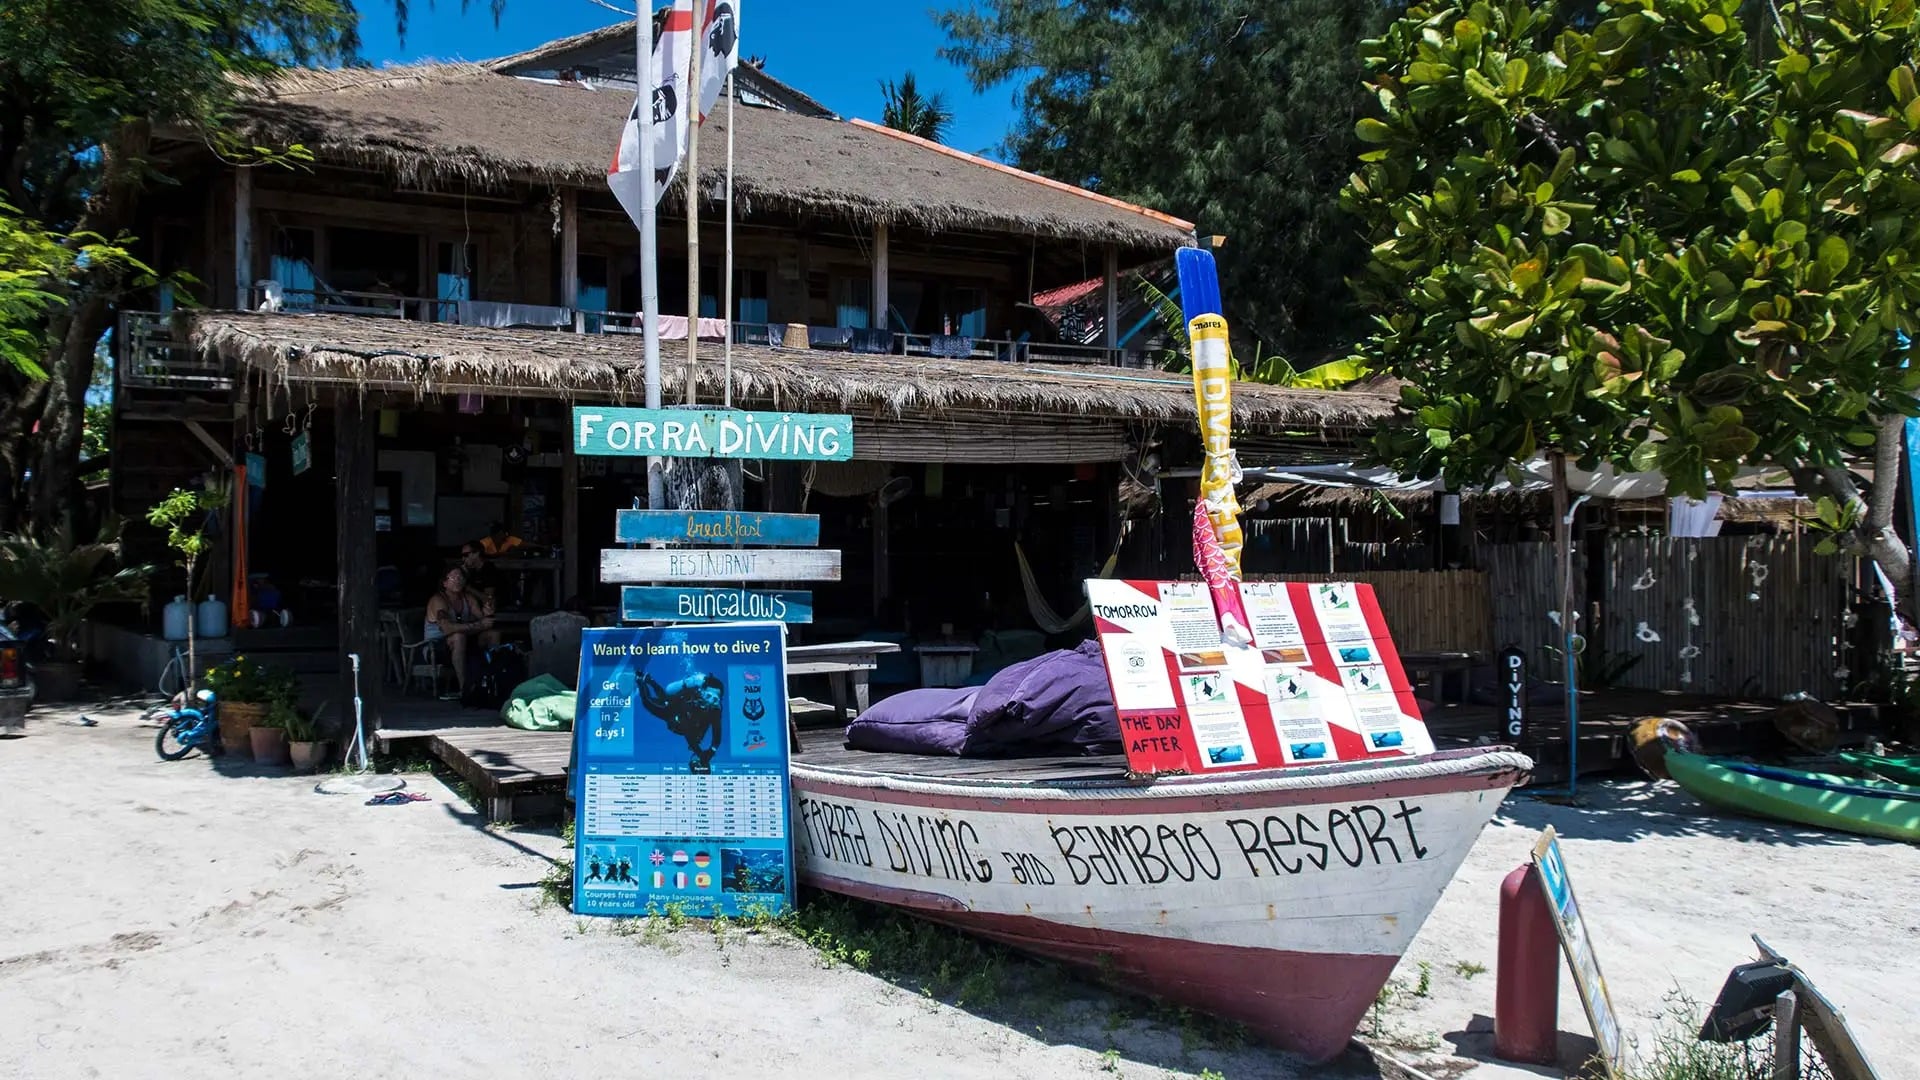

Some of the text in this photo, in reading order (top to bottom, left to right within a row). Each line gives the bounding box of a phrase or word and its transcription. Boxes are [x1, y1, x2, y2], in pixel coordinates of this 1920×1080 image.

[579, 414, 707, 452] FORRA
[686, 514, 763, 543] breakfast
[670, 553, 758, 576] RESTAURANT
[1094, 604, 1158, 618] TOMORROW
[593, 640, 771, 656] Want to learn how to dive ?
[602, 681, 620, 691] Get
[590, 696, 631, 707] certified
[601, 712, 619, 721] in 2
[1122, 716, 1151, 731] THE
[1158, 714, 1181, 730] DAY
[595, 728, 619, 739] days
[1132, 738, 1182, 753] AFTER
[584, 890, 637, 899] Courses from
[649, 893, 714, 902] Many languages
